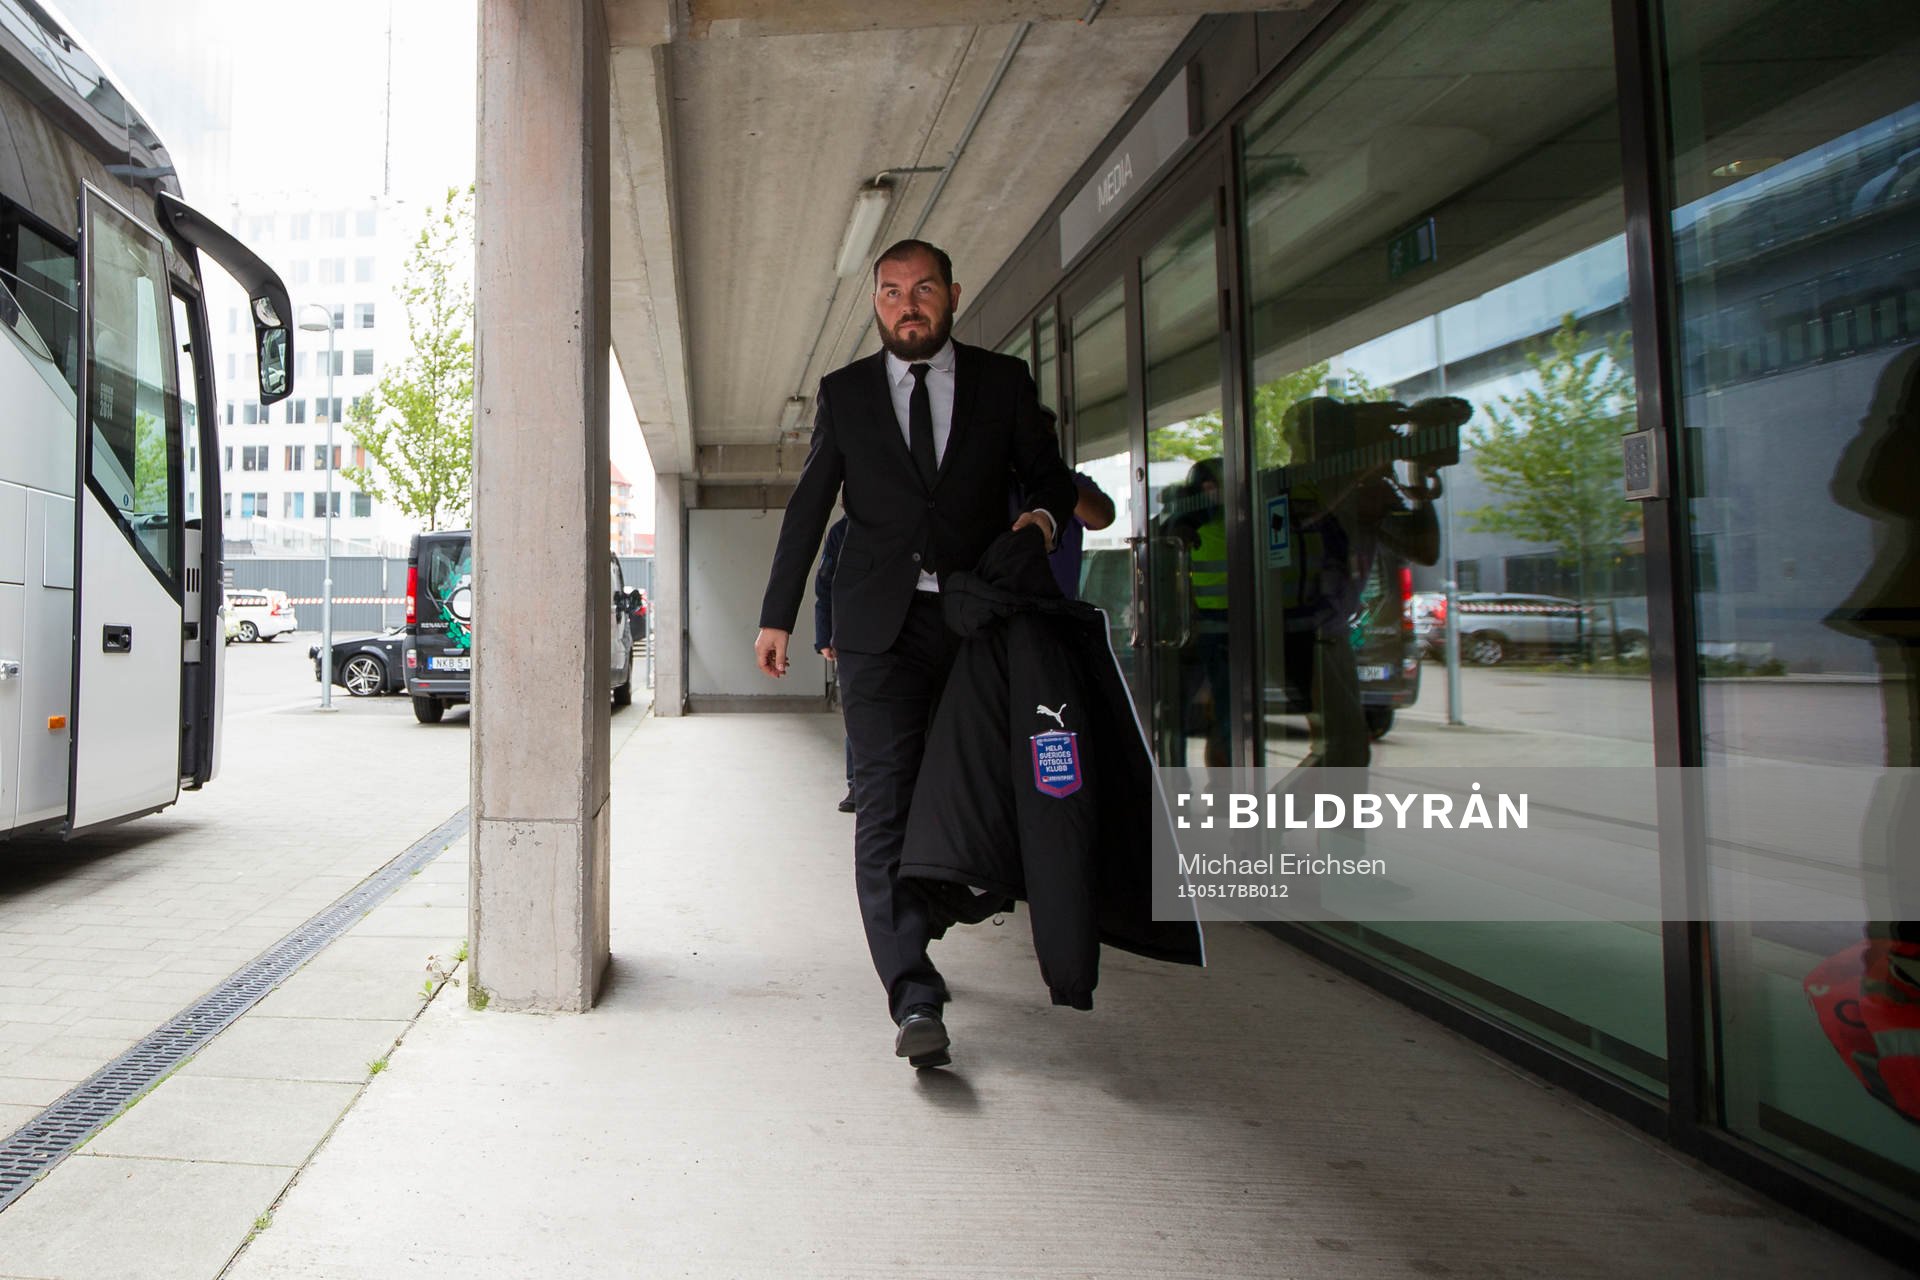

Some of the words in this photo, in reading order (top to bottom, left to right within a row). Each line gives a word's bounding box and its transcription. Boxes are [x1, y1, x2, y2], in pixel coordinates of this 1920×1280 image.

[1098, 153, 1133, 213] MEDIA
[436, 659, 455, 668] NKB
[1039, 751, 1071, 759] SVERIGES
[1039, 758, 1073, 766] FOTBOLLS
[1046, 765, 1068, 773] KLUBB
